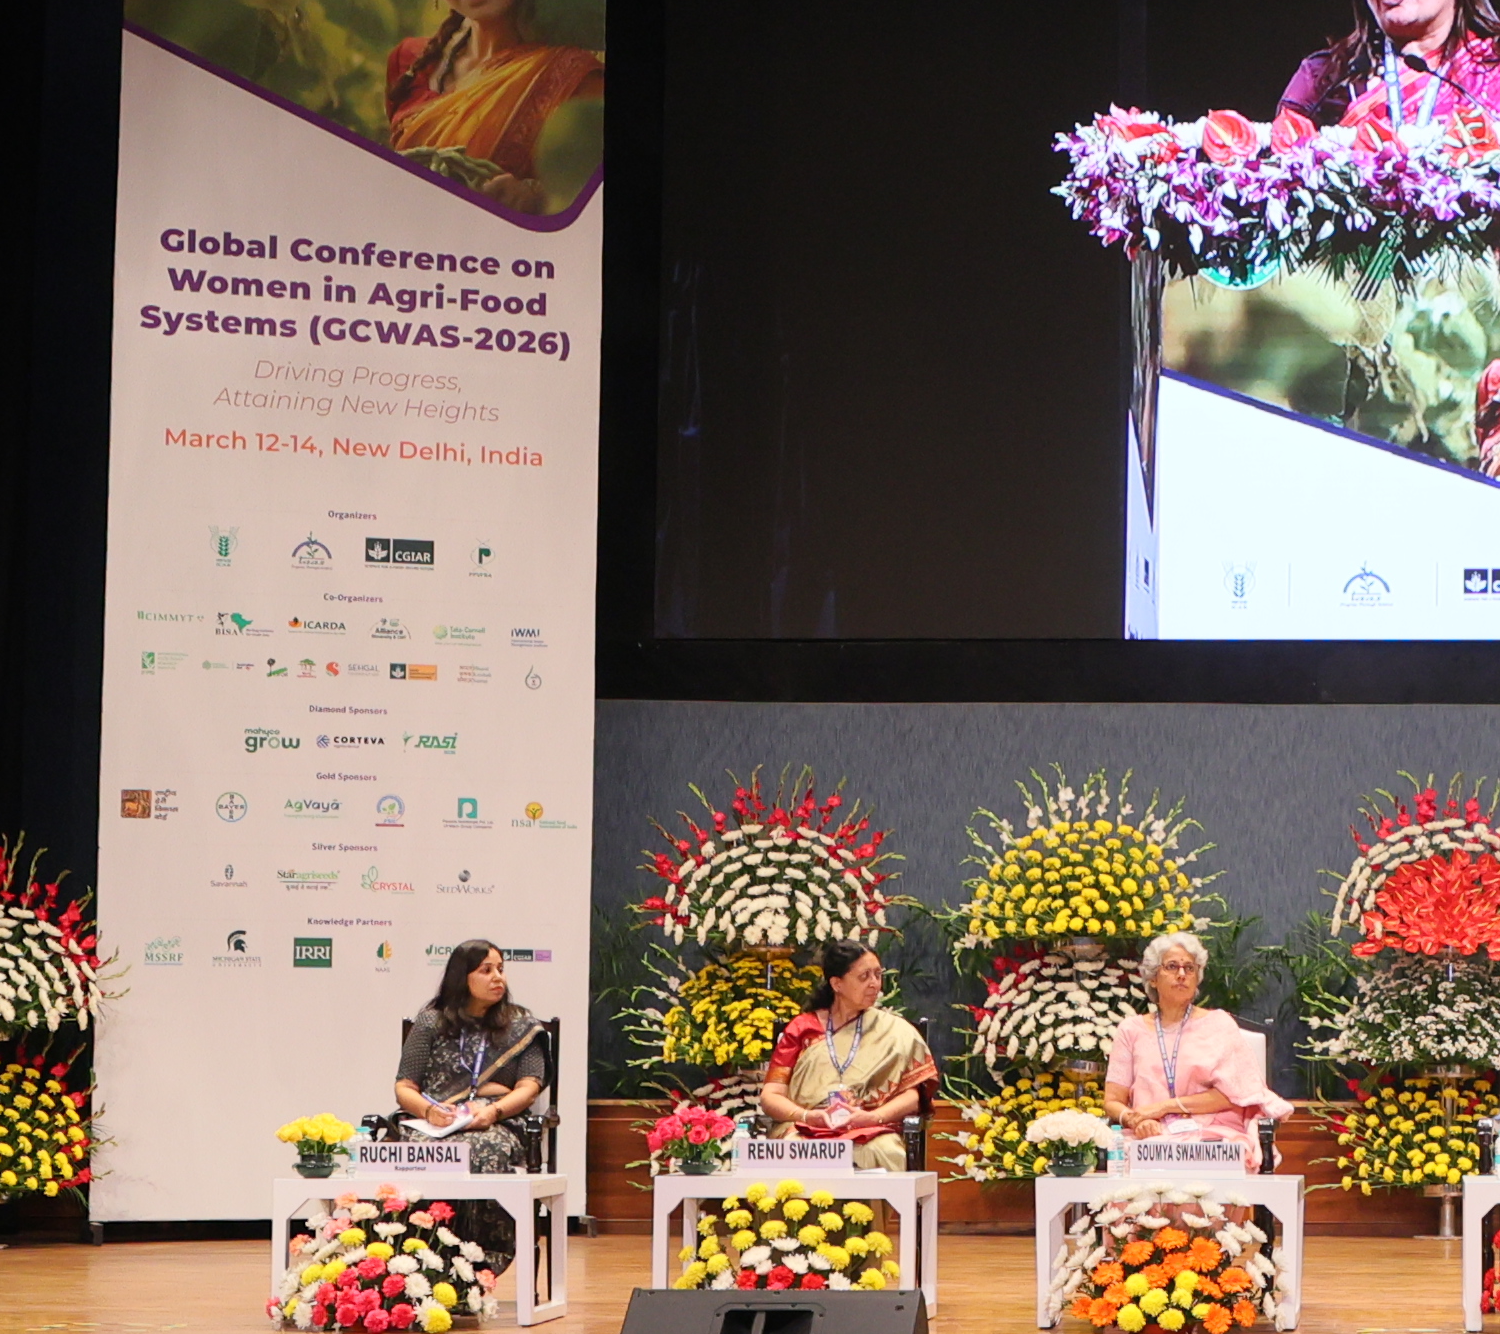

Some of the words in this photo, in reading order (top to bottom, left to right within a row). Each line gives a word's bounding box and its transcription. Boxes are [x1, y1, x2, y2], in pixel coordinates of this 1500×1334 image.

[161, 229, 277, 259] Global
[290, 238, 500, 275] Conference
[512, 259, 554, 279] on
[168, 268, 310, 300] Women
[324, 275, 356, 303] in
[368, 283, 546, 316] Agri-Food
[141, 305, 297, 337] Systems
[310, 315, 570, 361] (GCWAS-2026)
[255, 360, 344, 387] Driving
[353, 366, 461, 393] Progress,
[213, 388, 333, 416] Attaining
[341, 395, 398, 415] New
[404, 399, 499, 424] Heights
[166, 428, 246, 450] March
[256, 433, 323, 457] 12-14,
[333, 438, 390, 457] New
[400, 441, 471, 465] Delhi,
[481, 446, 543, 466] India
[328, 510, 377, 520] Organizers
[395, 550, 431, 564] CGIAR
[324, 593, 383, 603] Co-Organizers
[303, 620, 346, 630] ICARDA
[309, 705, 346, 713] Diamond
[349, 706, 387, 715] Sponsors
[245, 736, 300, 753] grow
[334, 736, 384, 745] CORTEVA
[317, 772, 335, 781] Gold
[338, 773, 376, 782] Sponsors
[312, 843, 336, 852] Silver
[339, 843, 378, 853] Sponsors
[372, 882, 415, 891] CRYSTAL
[307, 917, 353, 926] Knowledge
[145, 953, 183, 962] MSSRF
[295, 946, 330, 959] IRRI
[360, 1146, 401, 1163] RUCHI
[408, 1146, 461, 1162] BANSAL
[748, 1143, 784, 1159] RENU
[790, 1143, 845, 1159] SWARUP
[1137, 1145, 1173, 1161] SOUMYA
[1176, 1145, 1240, 1161] SWAMINATHAN
